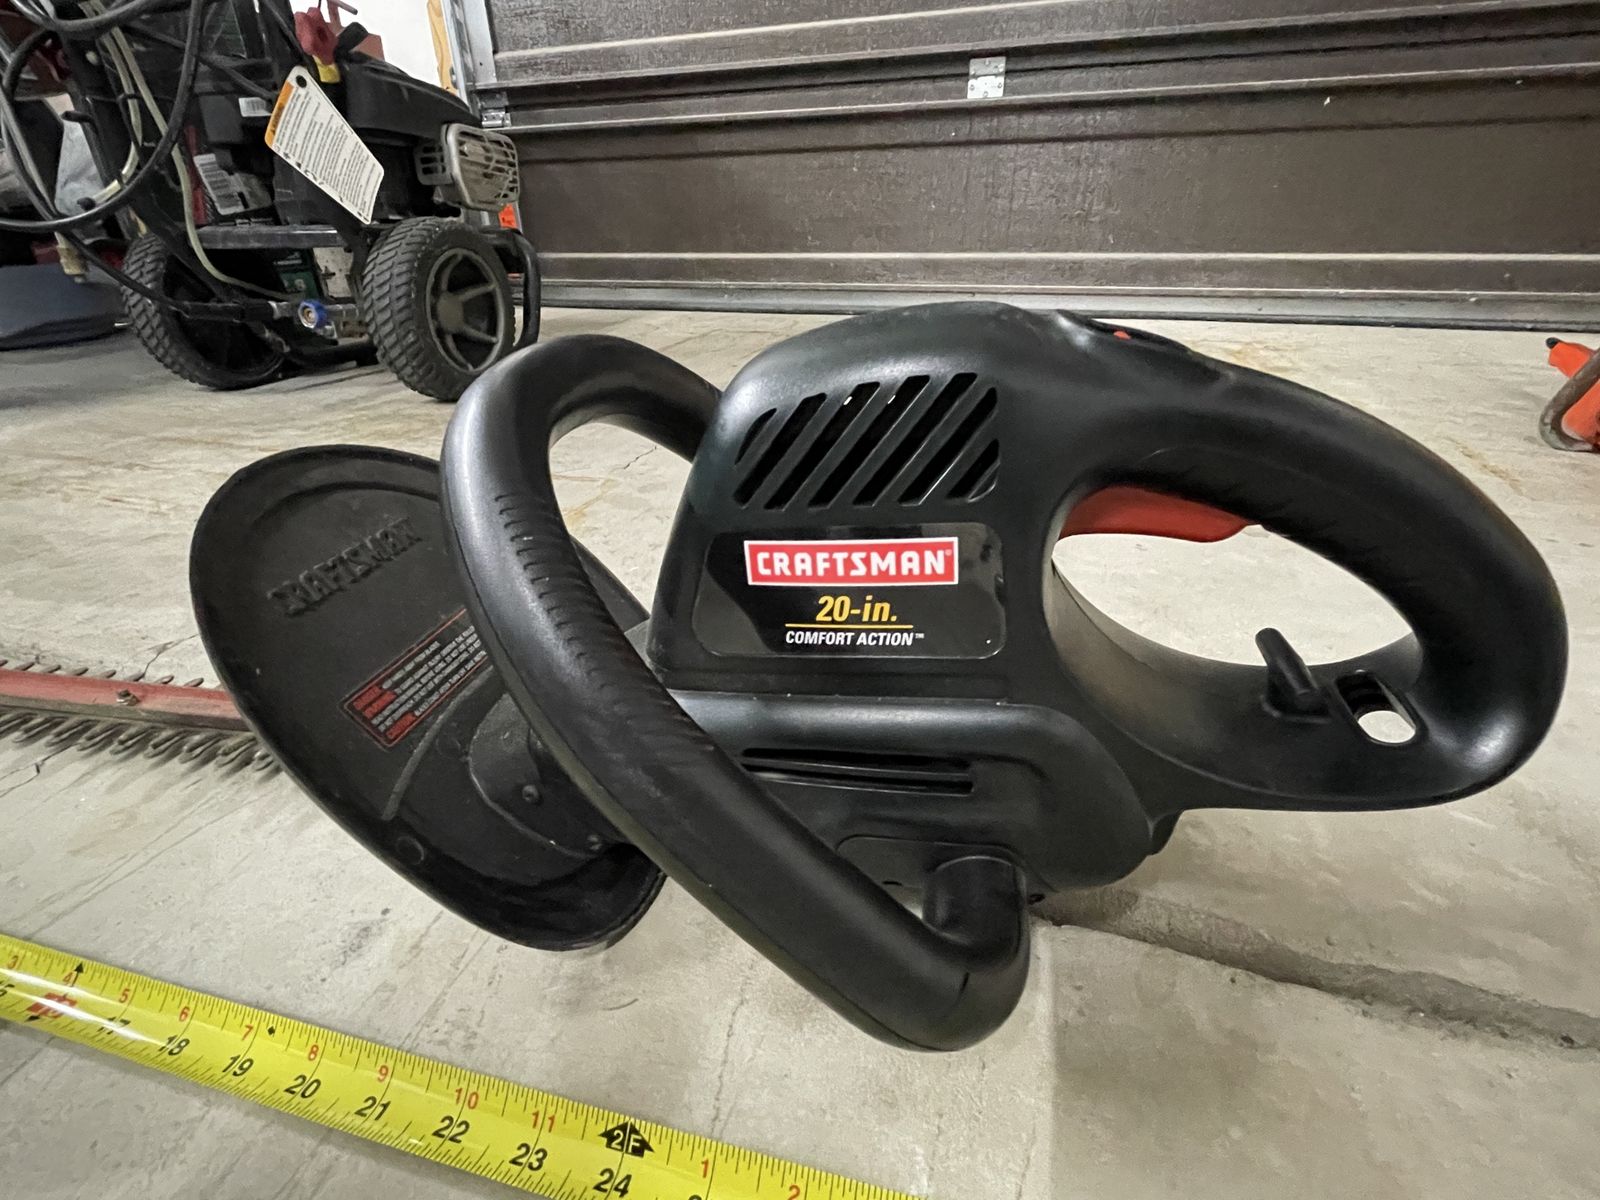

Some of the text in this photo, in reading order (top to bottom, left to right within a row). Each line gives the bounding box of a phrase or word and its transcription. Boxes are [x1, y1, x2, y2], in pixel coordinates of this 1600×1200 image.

[816, 595, 898, 622] 20-in.
[785, 630, 855, 646] COMFORT
[7, 955, 19, 970] 3
[63, 971, 74, 987] 4
[119, 988, 130, 1003] 5
[179, 1006, 190, 1022] 6
[242, 1025, 254, 1041] 7
[158, 1035, 190, 1056] 18
[307, 1044, 319, 1062] 8
[222, 1054, 254, 1078] 19
[377, 1065, 389, 1083] 9
[284, 1074, 322, 1099] 20
[354, 1095, 391, 1121] 21
[454, 1087, 479, 1110] 10
[432, 1115, 470, 1143] 22
[531, 1110, 556, 1134] 11
[509, 1142, 548, 1171] 23
[593, 1168, 633, 1198] 24
[787, 1184, 800, 1200] 2
